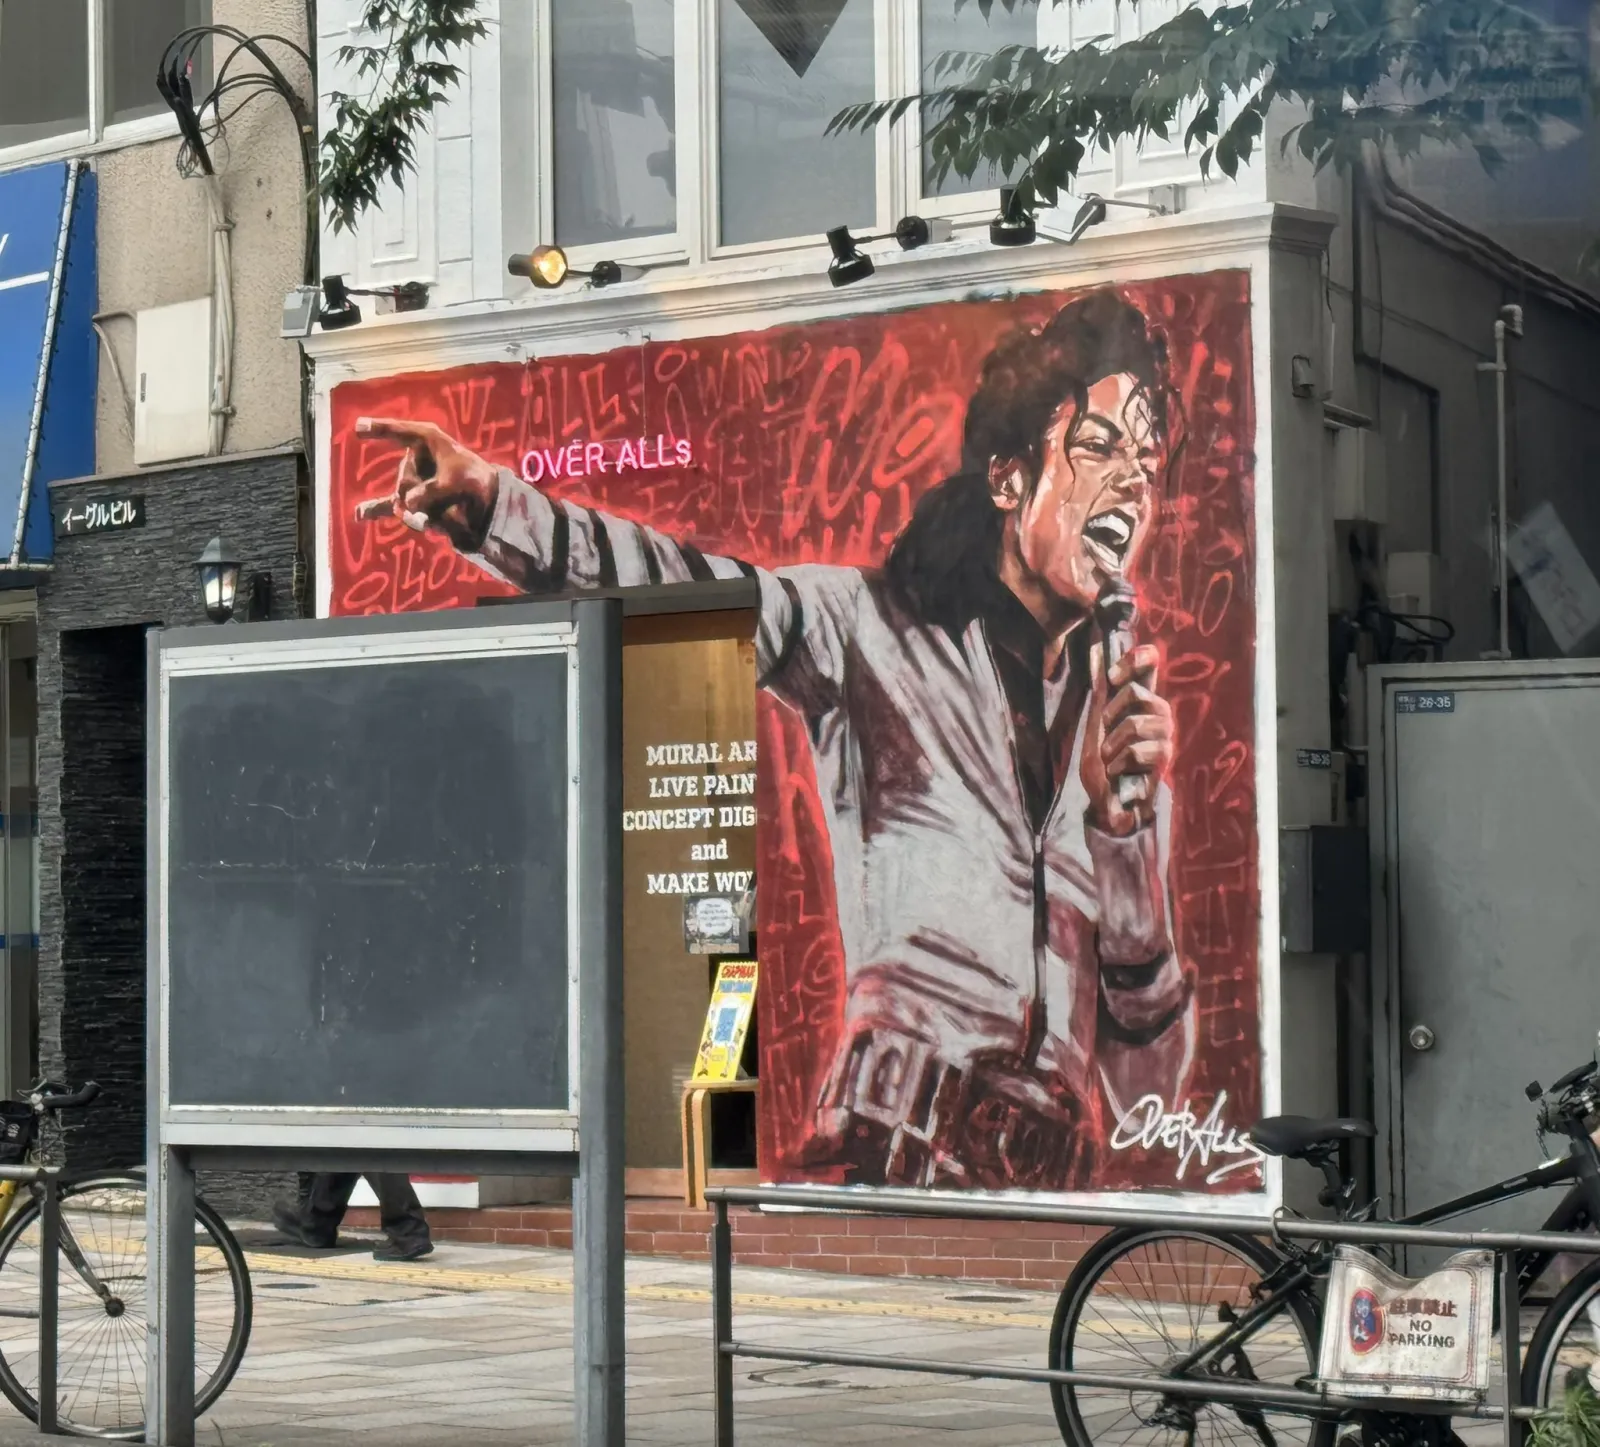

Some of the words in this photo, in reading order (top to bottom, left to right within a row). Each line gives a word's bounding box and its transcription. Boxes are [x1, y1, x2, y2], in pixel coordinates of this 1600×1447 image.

[521, 440, 606, 483] OVER
[646, 742, 724, 766] MURAL
[649, 775, 699, 798] LIVE
[622, 807, 715, 831] CONCEPT
[719, 805, 758, 828] DIG
[691, 838, 729, 861] and
[647, 871, 709, 894] MAKE
[1409, 1319, 1433, 1332] NO
[1388, 1332, 1456, 1349] PARKING
